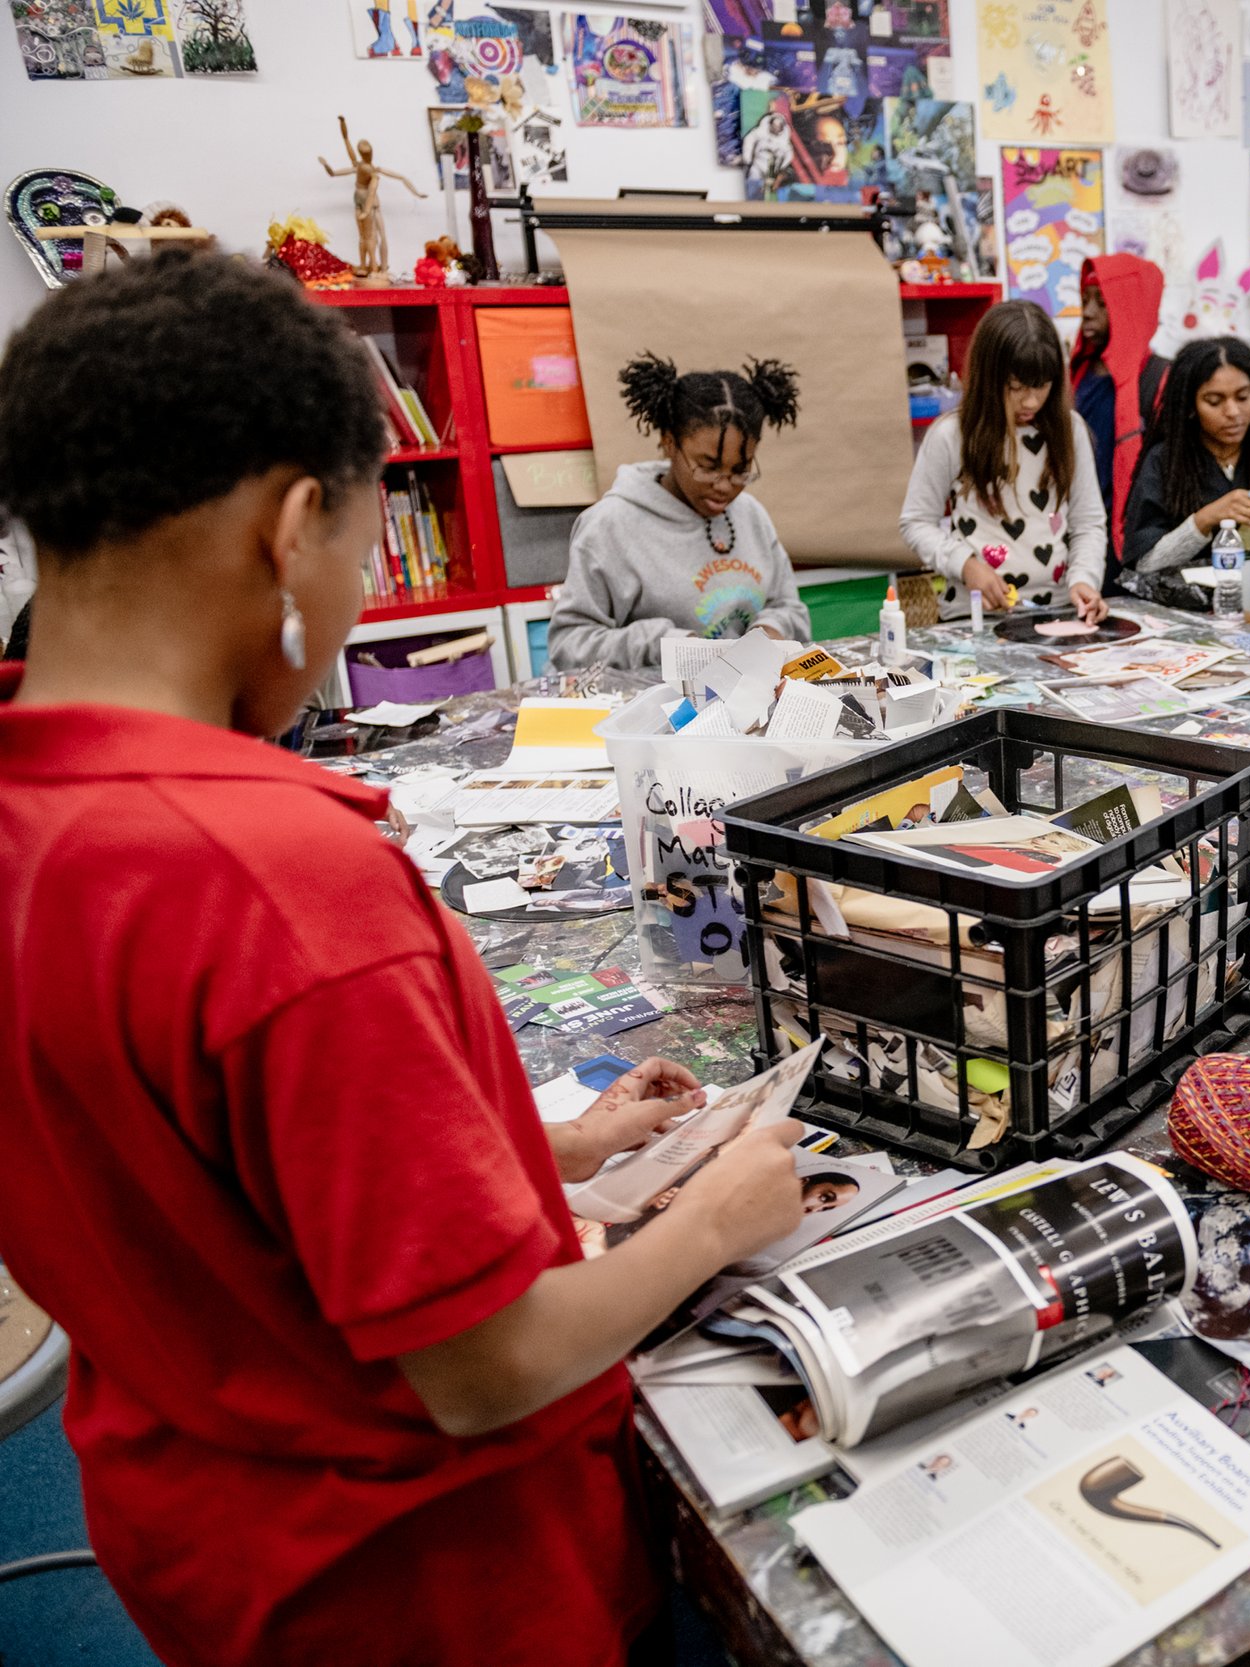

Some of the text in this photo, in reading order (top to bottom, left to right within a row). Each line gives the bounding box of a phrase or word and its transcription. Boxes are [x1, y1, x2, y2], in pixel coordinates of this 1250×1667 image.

[694, 559, 762, 593] AWESOME
[799, 652, 829, 670] IOWA
[582, 1003, 635, 1023] JUNE
[1018, 1207, 1066, 1248] CASTELLI
